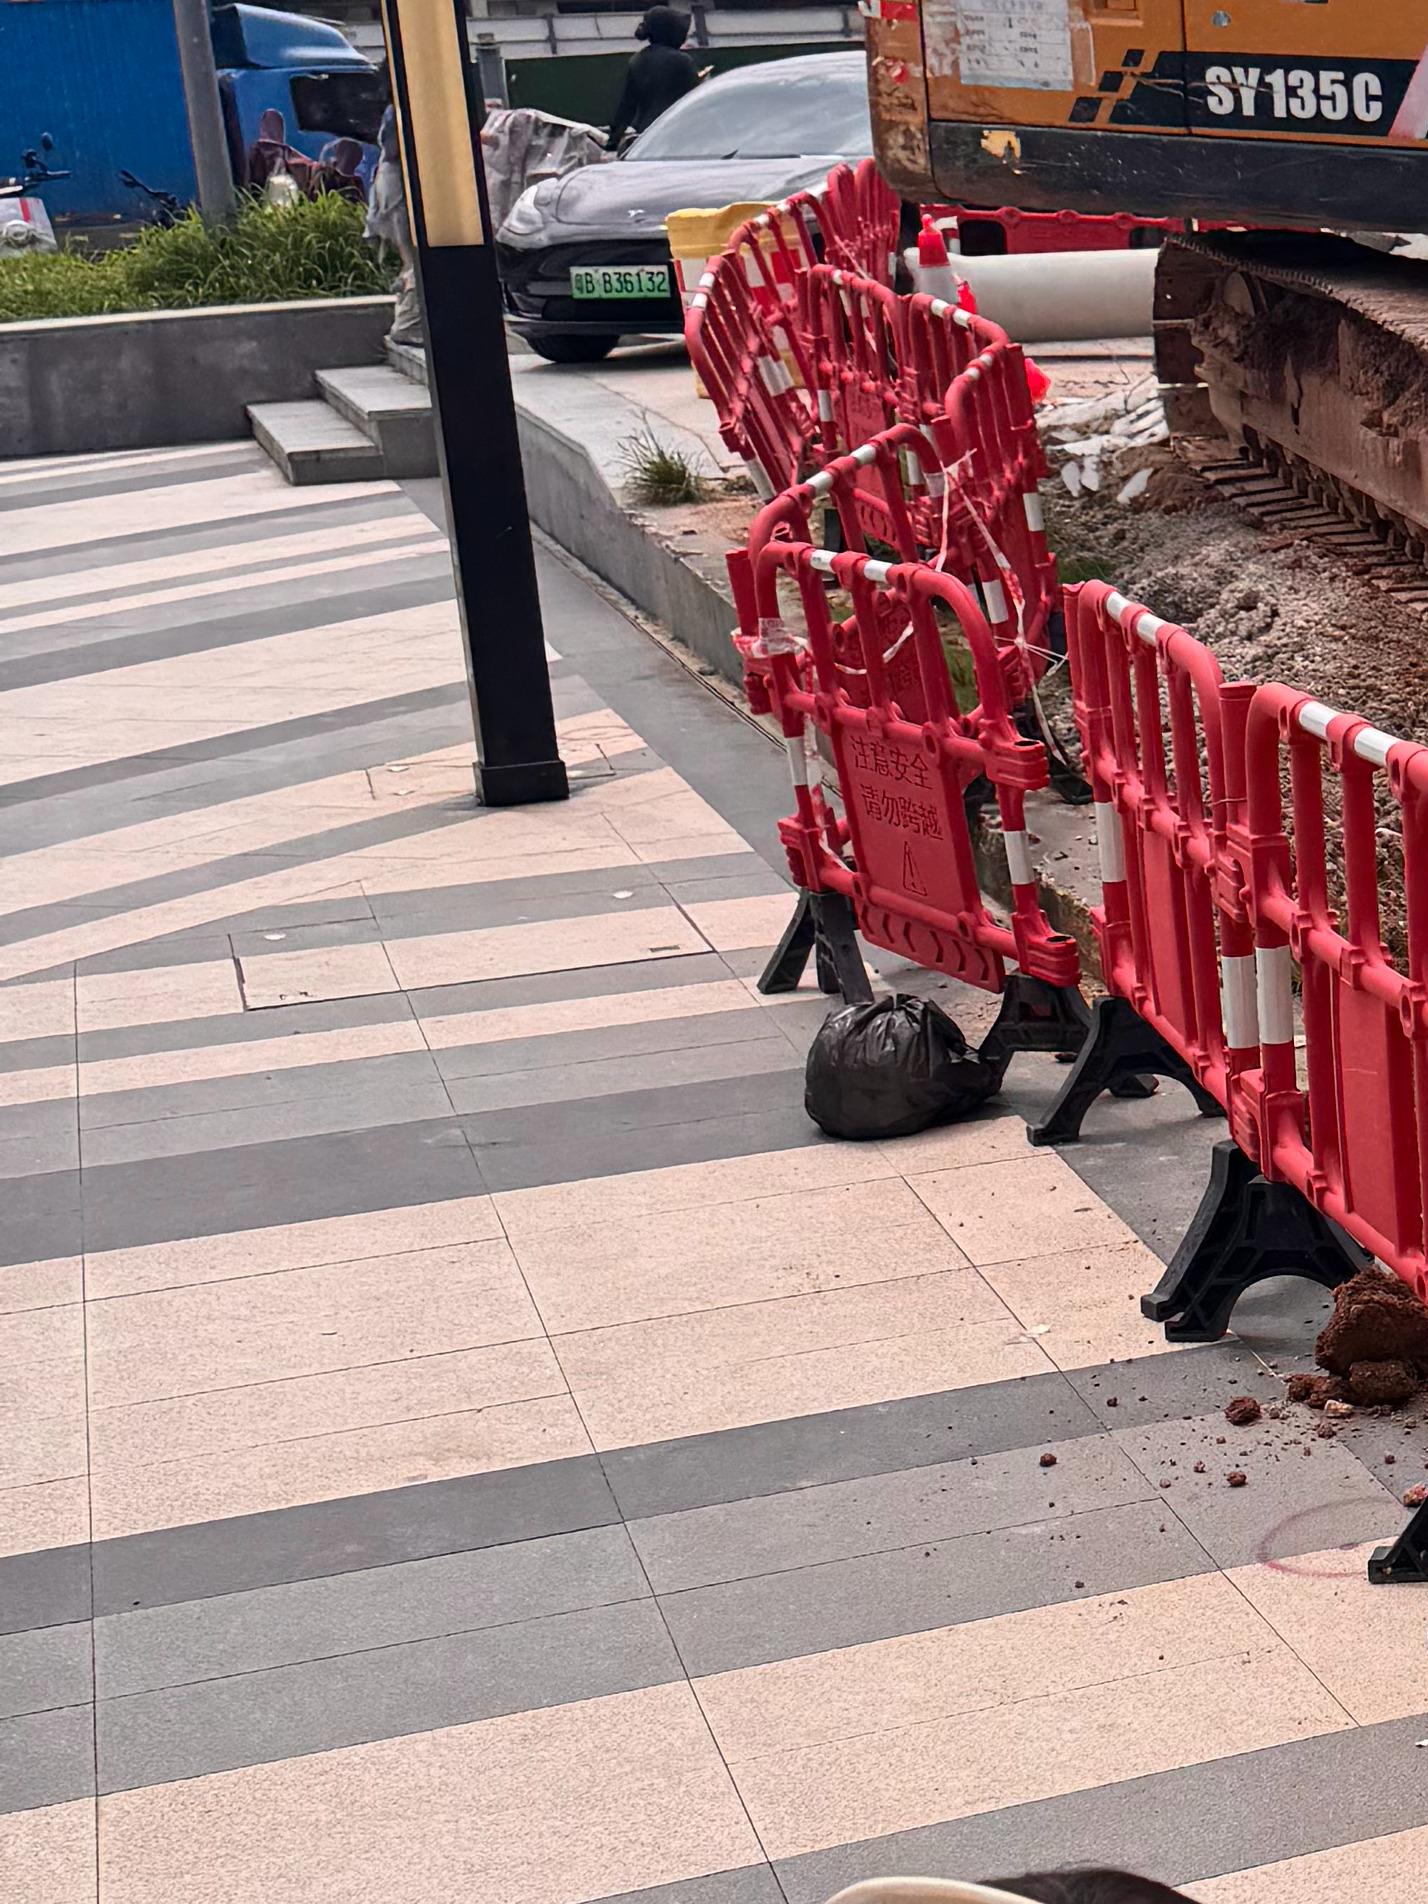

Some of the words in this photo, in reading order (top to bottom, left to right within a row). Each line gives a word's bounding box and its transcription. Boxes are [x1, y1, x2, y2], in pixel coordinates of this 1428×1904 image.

[1205, 65, 1384, 123] SY135C
[602, 270, 668, 294] B36132
[850, 735, 934, 790] 注意安全
[859, 782, 945, 841] 请勿跨越
